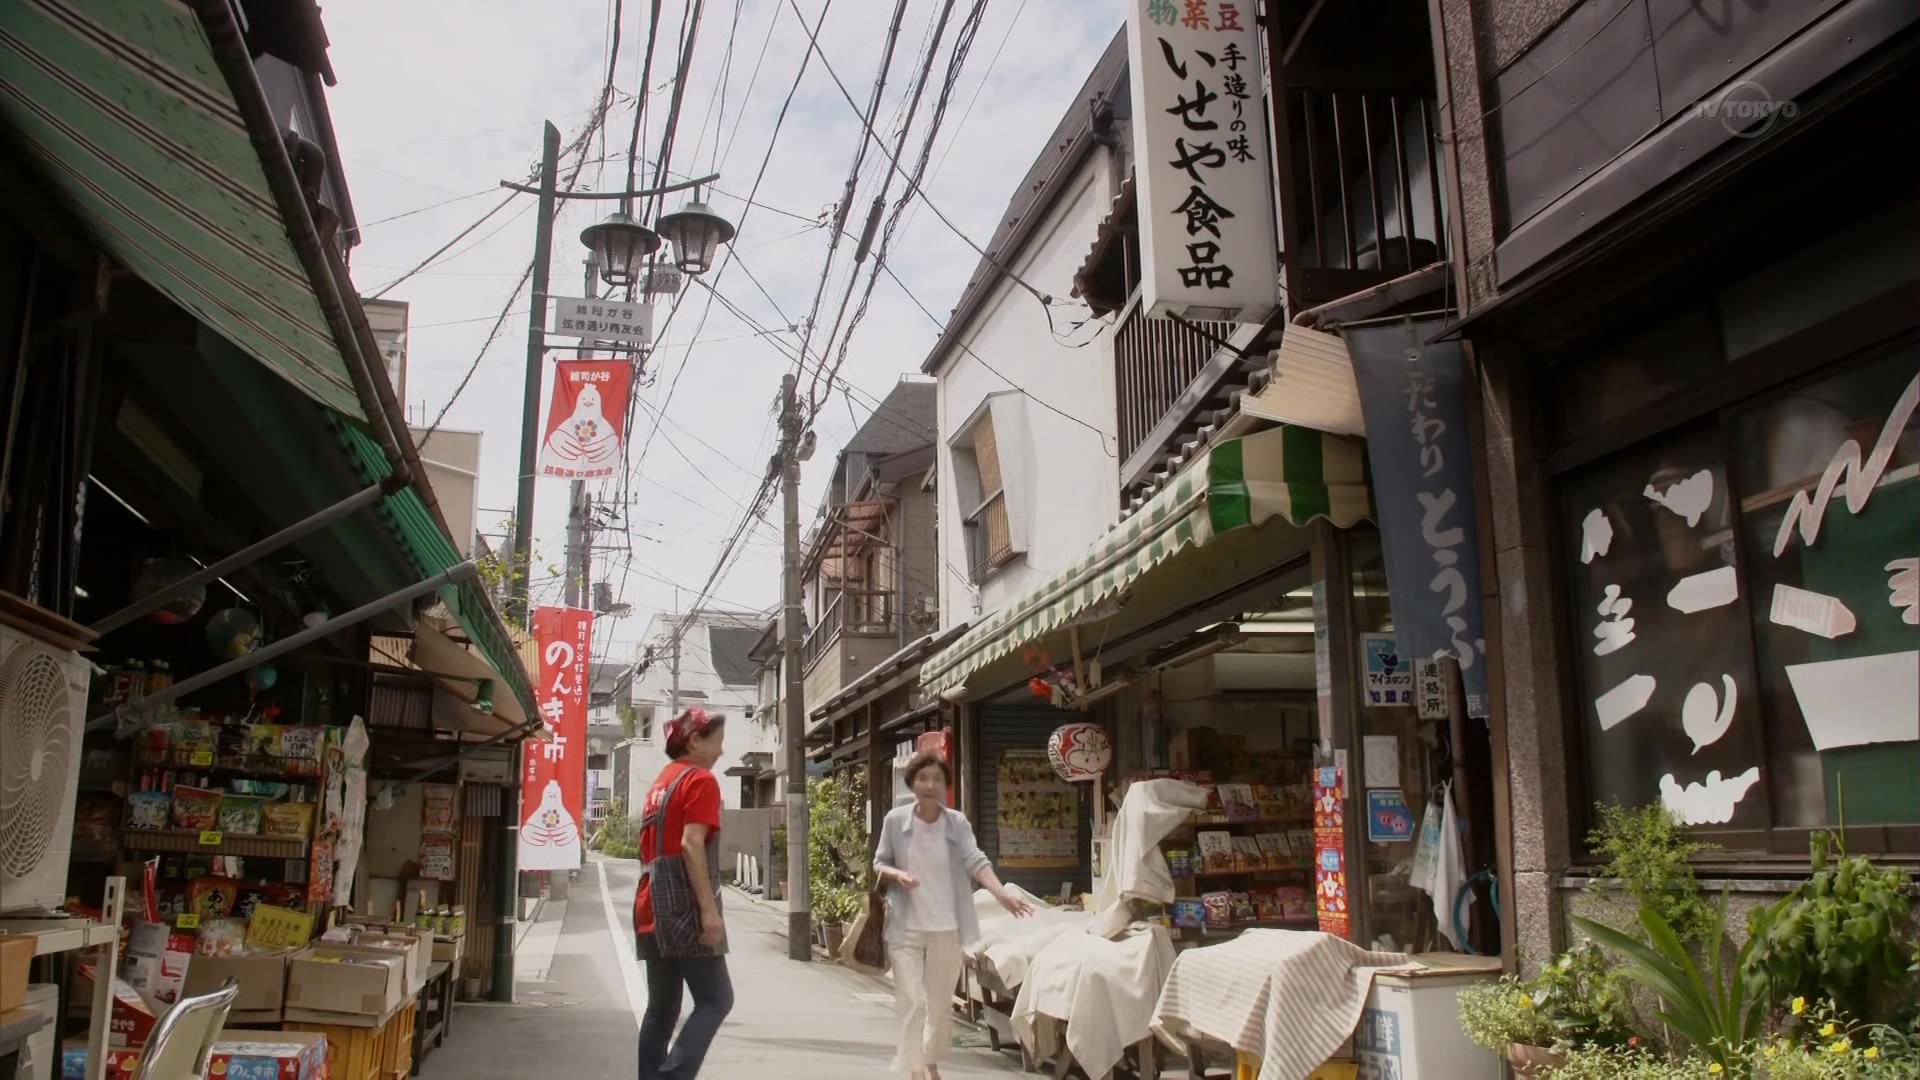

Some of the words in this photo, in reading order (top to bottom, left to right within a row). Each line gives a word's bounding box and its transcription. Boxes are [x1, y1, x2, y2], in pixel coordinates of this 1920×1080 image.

[1157, 36, 1235, 290] いせや食品
[1219, 42, 1256, 164] 手造りの味
[543, 640, 574, 763] のんき市
[1424, 662, 1441, 713] 連絡所
